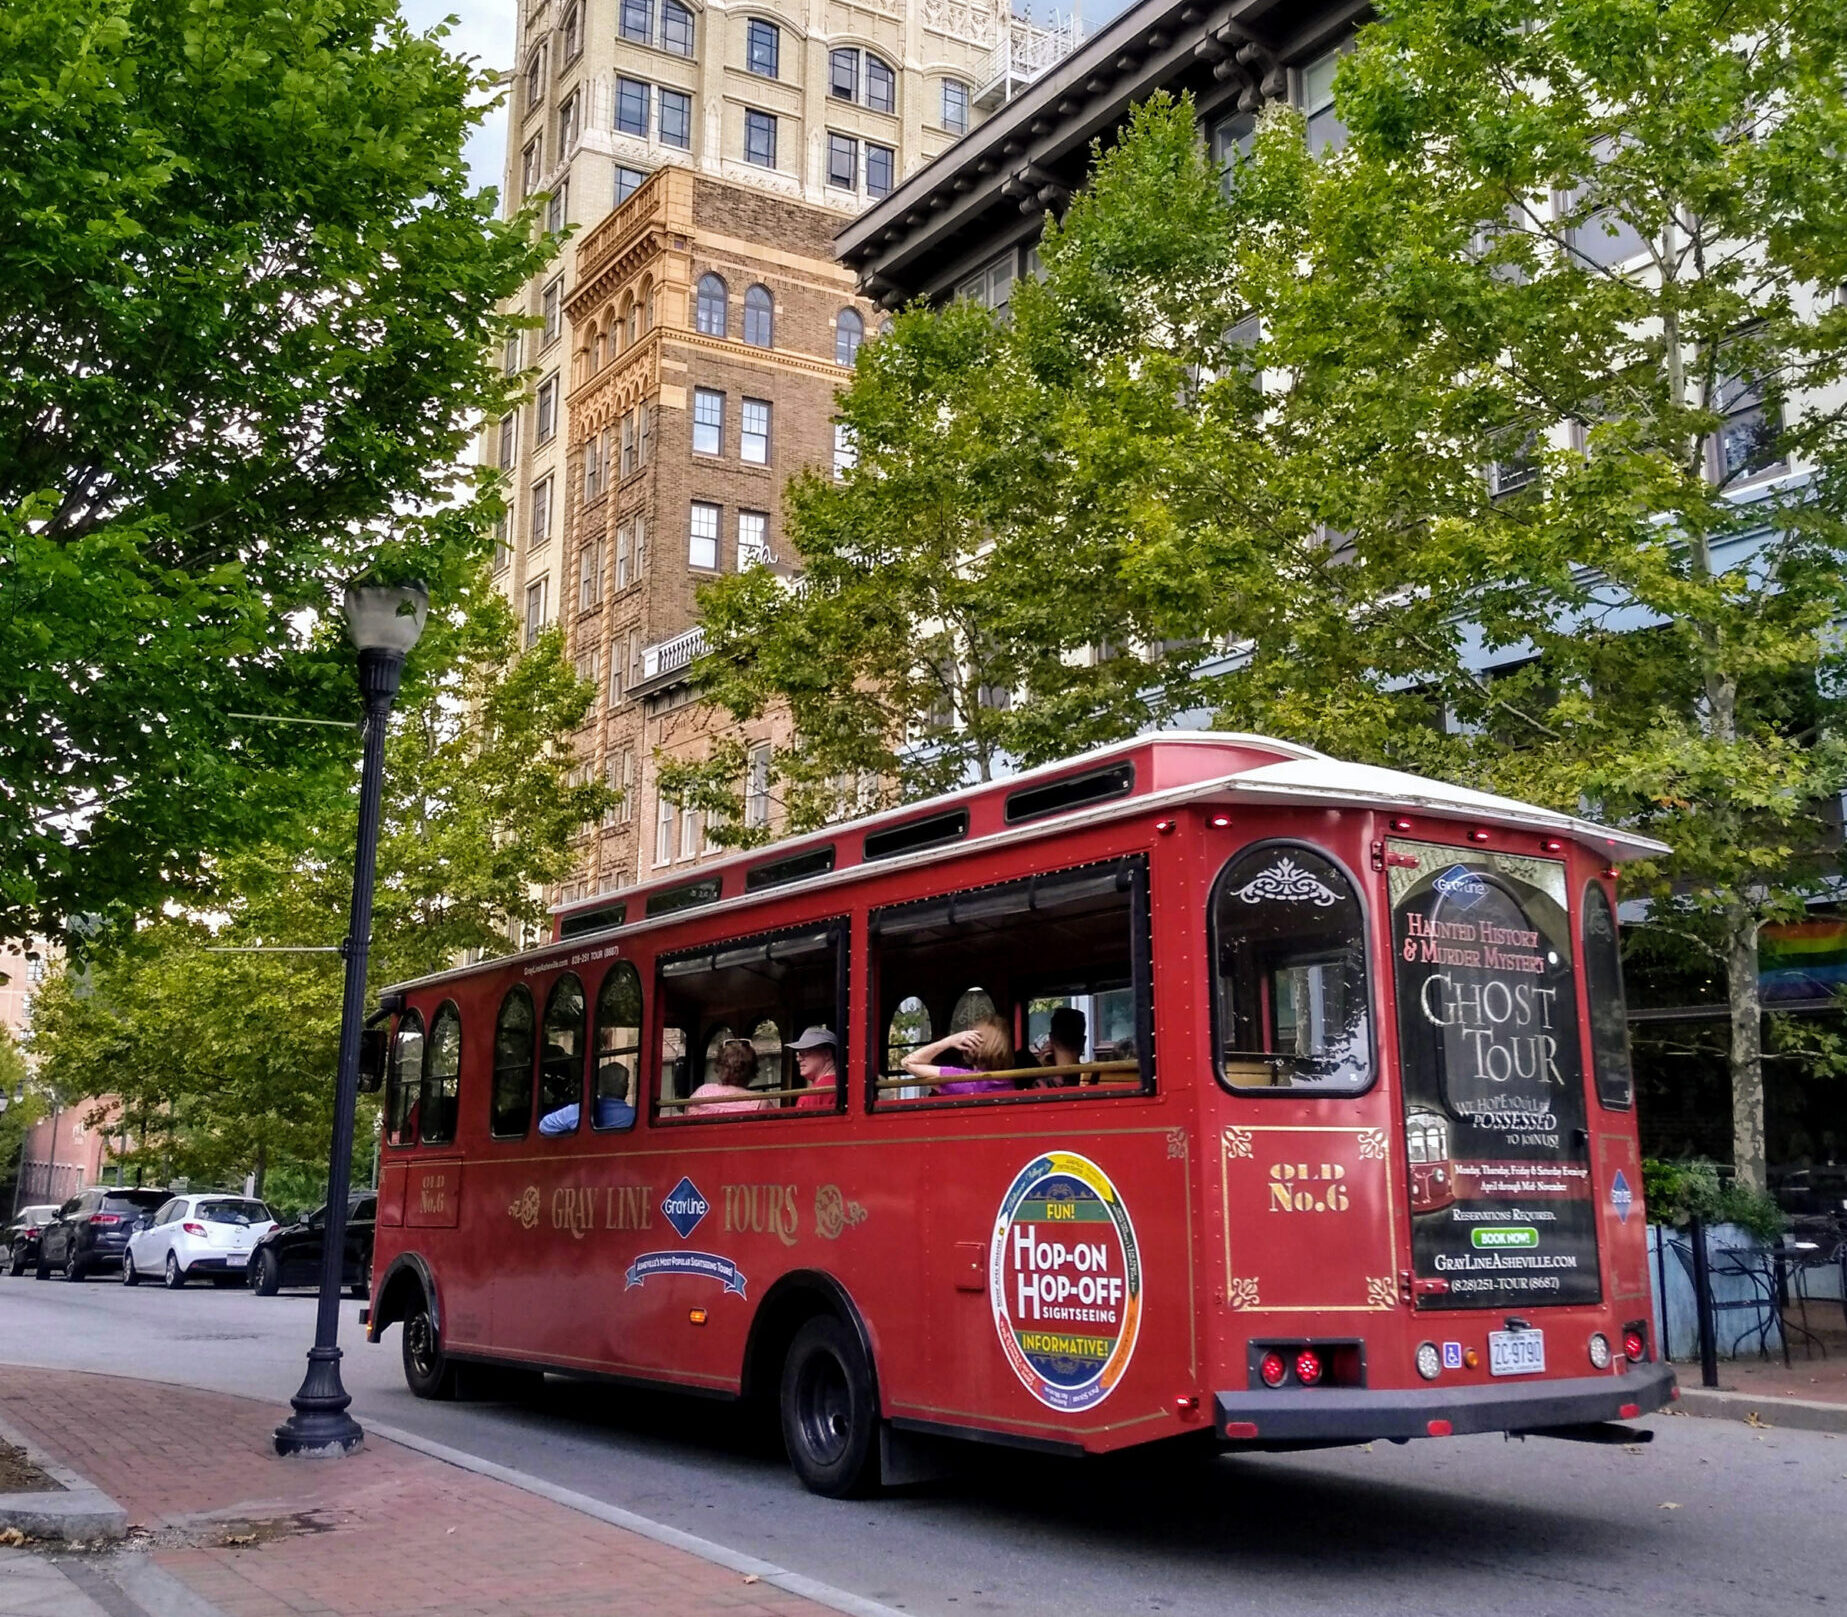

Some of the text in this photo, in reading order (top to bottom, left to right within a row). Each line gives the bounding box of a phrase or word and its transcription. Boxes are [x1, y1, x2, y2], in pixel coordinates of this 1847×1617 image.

[1479, 920, 1539, 949] HISTORY
[1403, 938, 1545, 974] & MURDER MYSTERY
[1420, 971, 1557, 1030] GHOST
[1462, 1023, 1566, 1086] TOUR
[1473, 1110, 1557, 1131] POSSESSED
[1269, 1163, 1346, 1180] OLD
[1046, 1203, 1076, 1219] FUN!
[1268, 1183, 1350, 1212] No.6
[551, 1185, 653, 1240] GRAY LINE
[720, 1184, 799, 1246] TOURS
[1013, 1224, 1108, 1272] HOP-ON
[1480, 1232, 1507, 1245] BOOK
[1017, 1272, 1122, 1320] HOP-OFF
[1042, 1306, 1117, 1323] SIGHTSEEING
[1022, 1333, 1109, 1357] INFORMATIVE!
